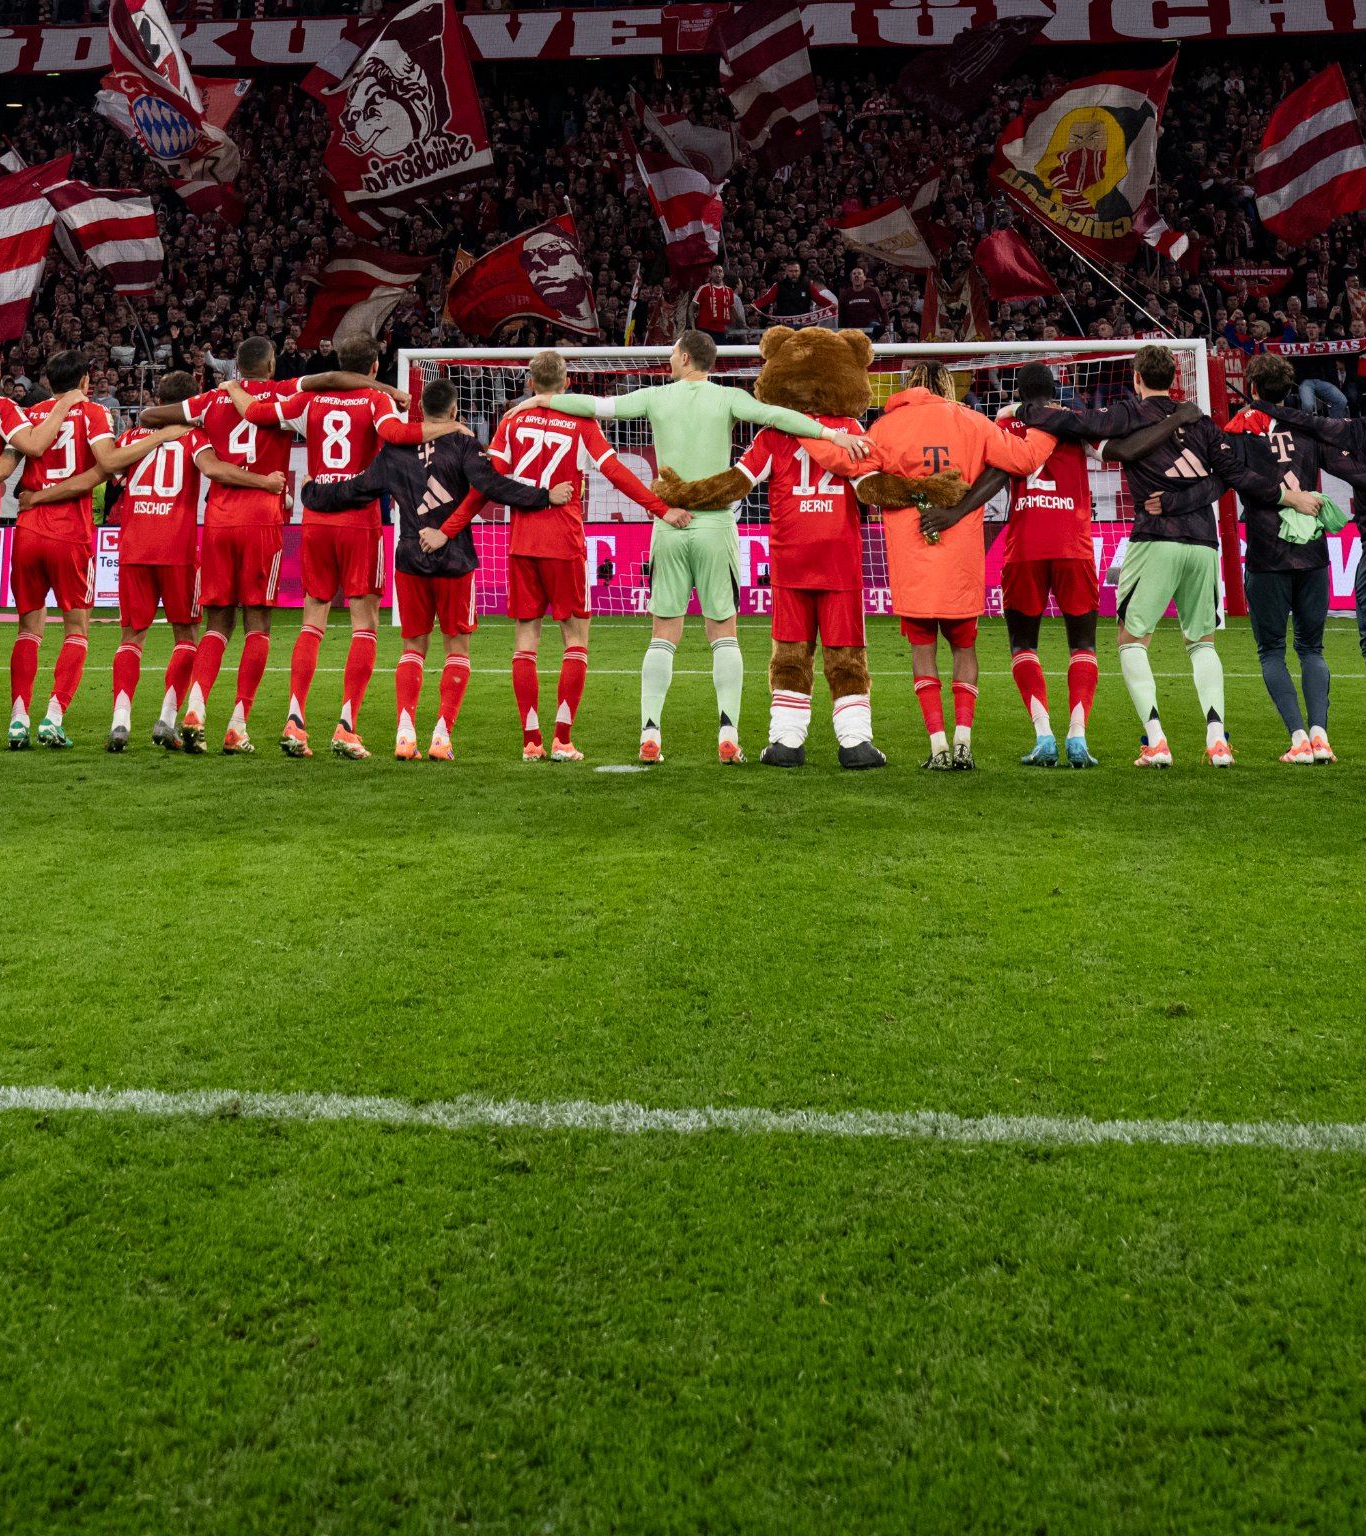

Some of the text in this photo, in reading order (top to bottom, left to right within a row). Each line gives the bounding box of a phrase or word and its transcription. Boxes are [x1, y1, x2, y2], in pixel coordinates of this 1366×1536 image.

[46, 421, 77, 479] 3
[229, 419, 257, 463] 4
[322, 410, 351, 469] 8
[513, 427, 573, 490] 27
[923, 447, 949, 474] T
[1269, 432, 1295, 463] T
[129, 440, 184, 497] 20
[792, 446, 845, 495] 12
[800, 500, 833, 513] BERNI
